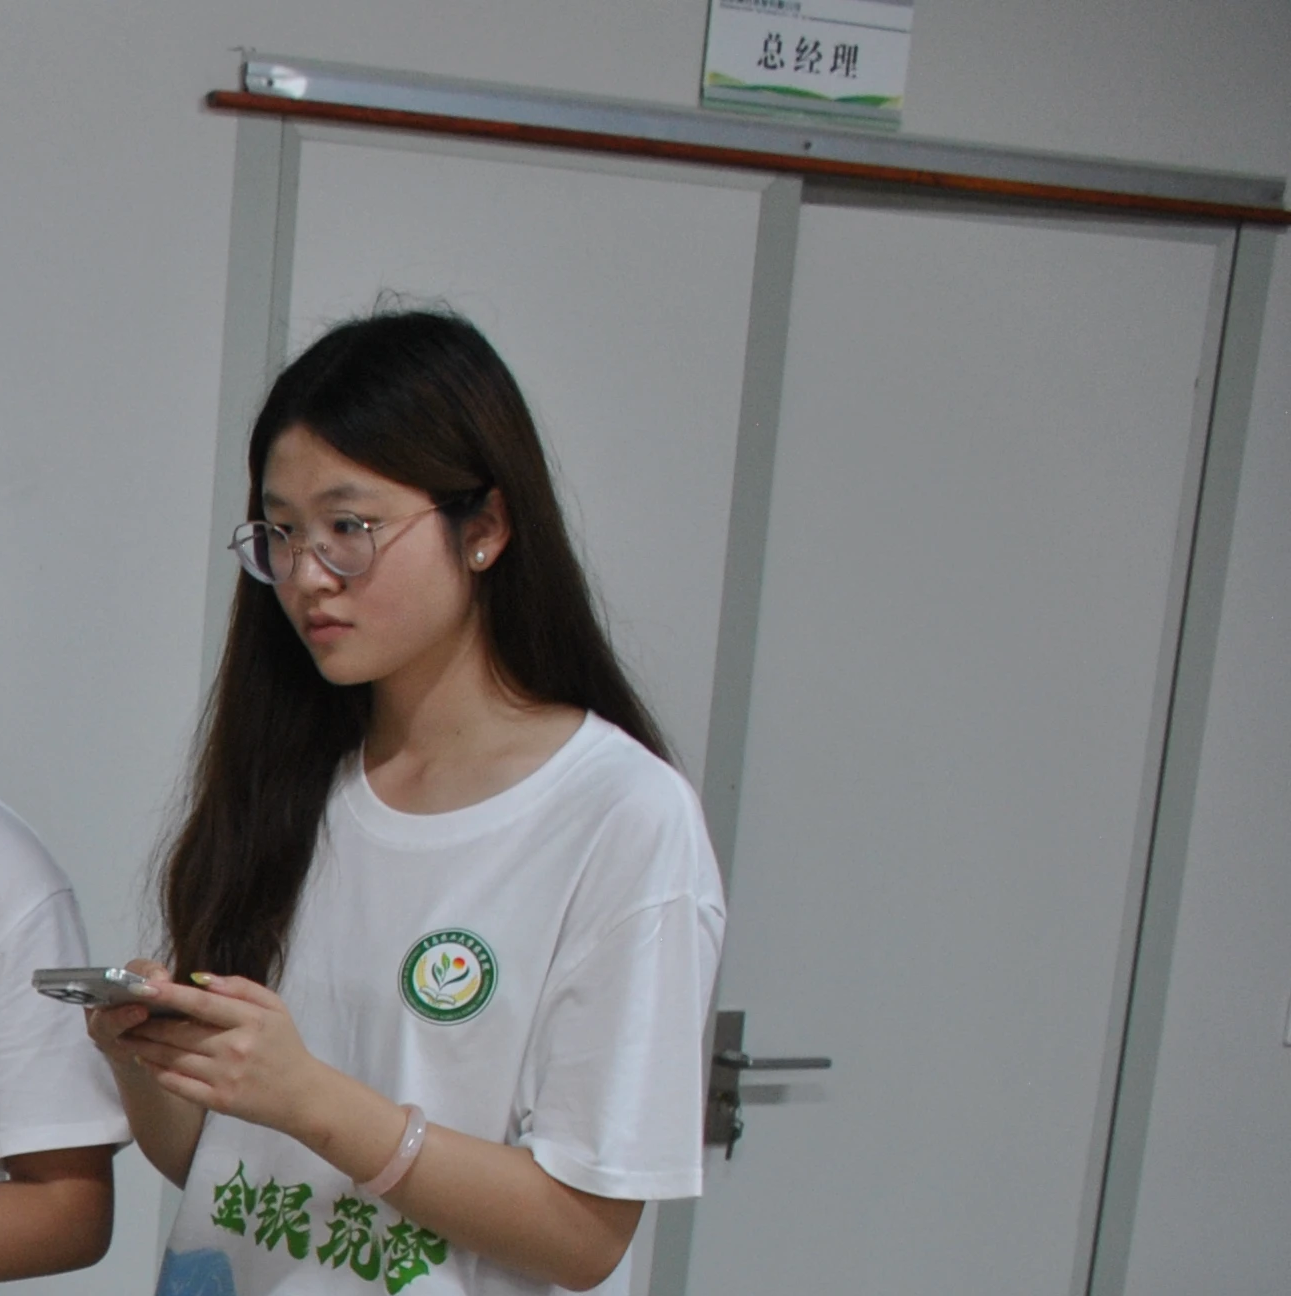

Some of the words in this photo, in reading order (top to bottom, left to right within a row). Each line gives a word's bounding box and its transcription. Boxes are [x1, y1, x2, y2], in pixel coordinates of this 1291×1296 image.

[757, 32, 859, 78] 总经理
[211, 1159, 448, 1295] 金银筑梦
